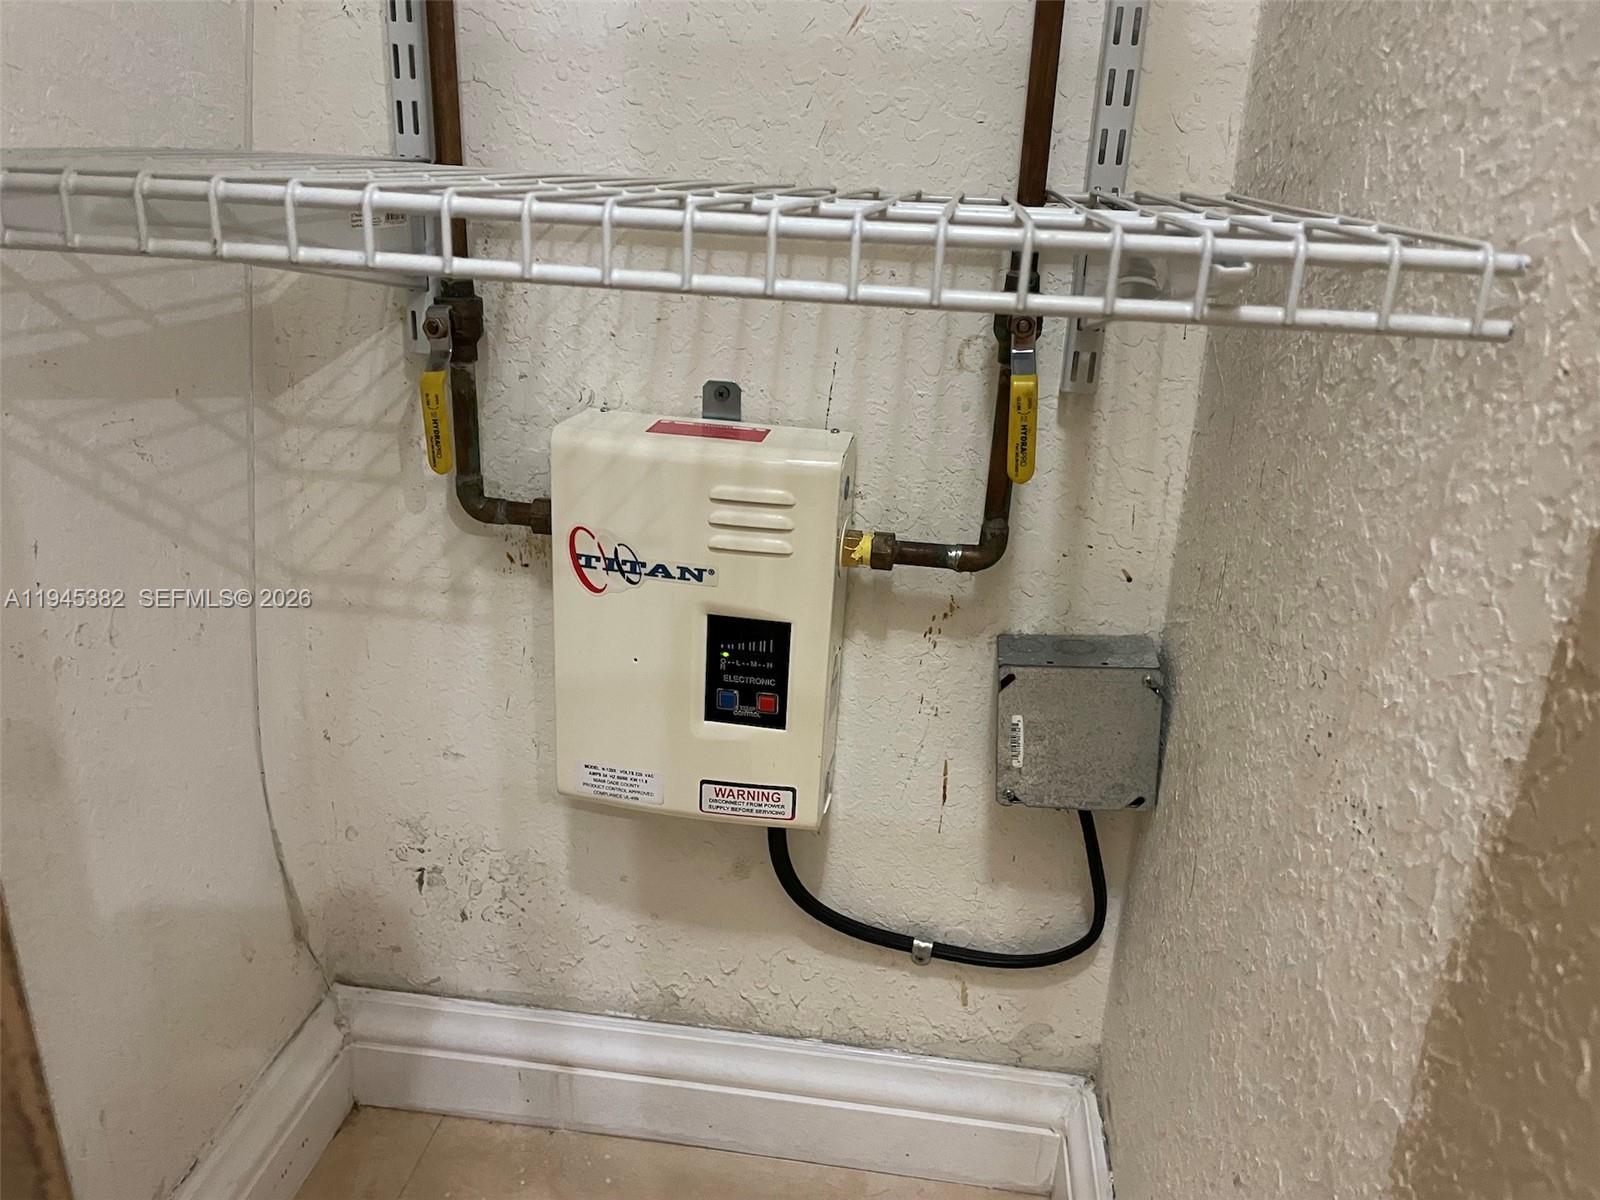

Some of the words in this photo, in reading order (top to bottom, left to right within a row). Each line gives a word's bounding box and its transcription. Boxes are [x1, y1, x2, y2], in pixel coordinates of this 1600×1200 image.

[1020, 424, 1028, 467] HYDRAPRO
[723, 674, 776, 686] ELECTRONIC
[593, 789, 622, 799] COMPLIANCE
[605, 785, 627, 793] CONTROL
[628, 789, 655, 797] APPROVED
[714, 787, 781, 803] WARNING
[709, 798, 745, 807] DISCONNECT
[764, 802, 786, 810] POWER
[731, 806, 754, 814] BEFORE
